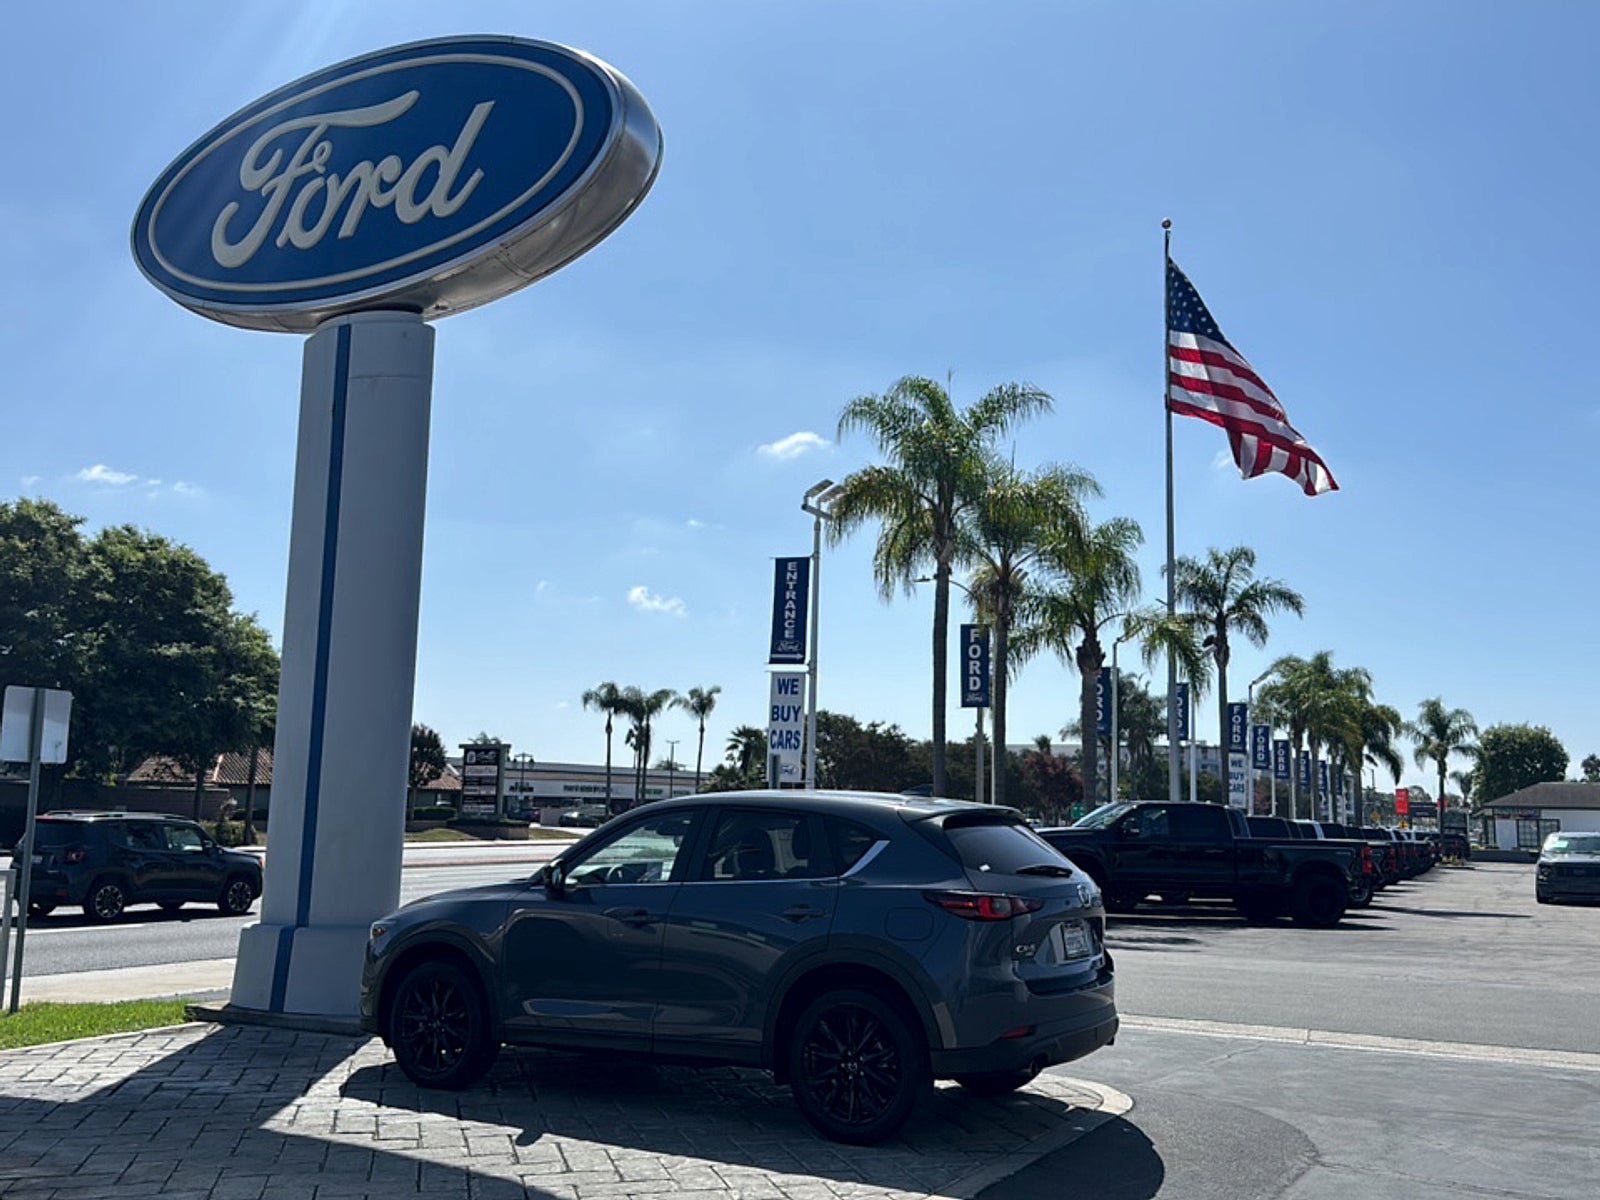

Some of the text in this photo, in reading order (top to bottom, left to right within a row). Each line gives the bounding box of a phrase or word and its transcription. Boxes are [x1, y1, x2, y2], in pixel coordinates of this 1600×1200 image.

[210, 89, 496, 269] Ford
[784, 561, 798, 639] ENTRANCE
[969, 628, 982, 691] FORD
[777, 678, 799, 694] WE
[771, 705, 801, 722] BUY
[1231, 705, 1242, 744] FORD
[770, 730, 801, 750] CARS
[1256, 728, 1265, 761] FORD
[1277, 742, 1285, 772] FORD
